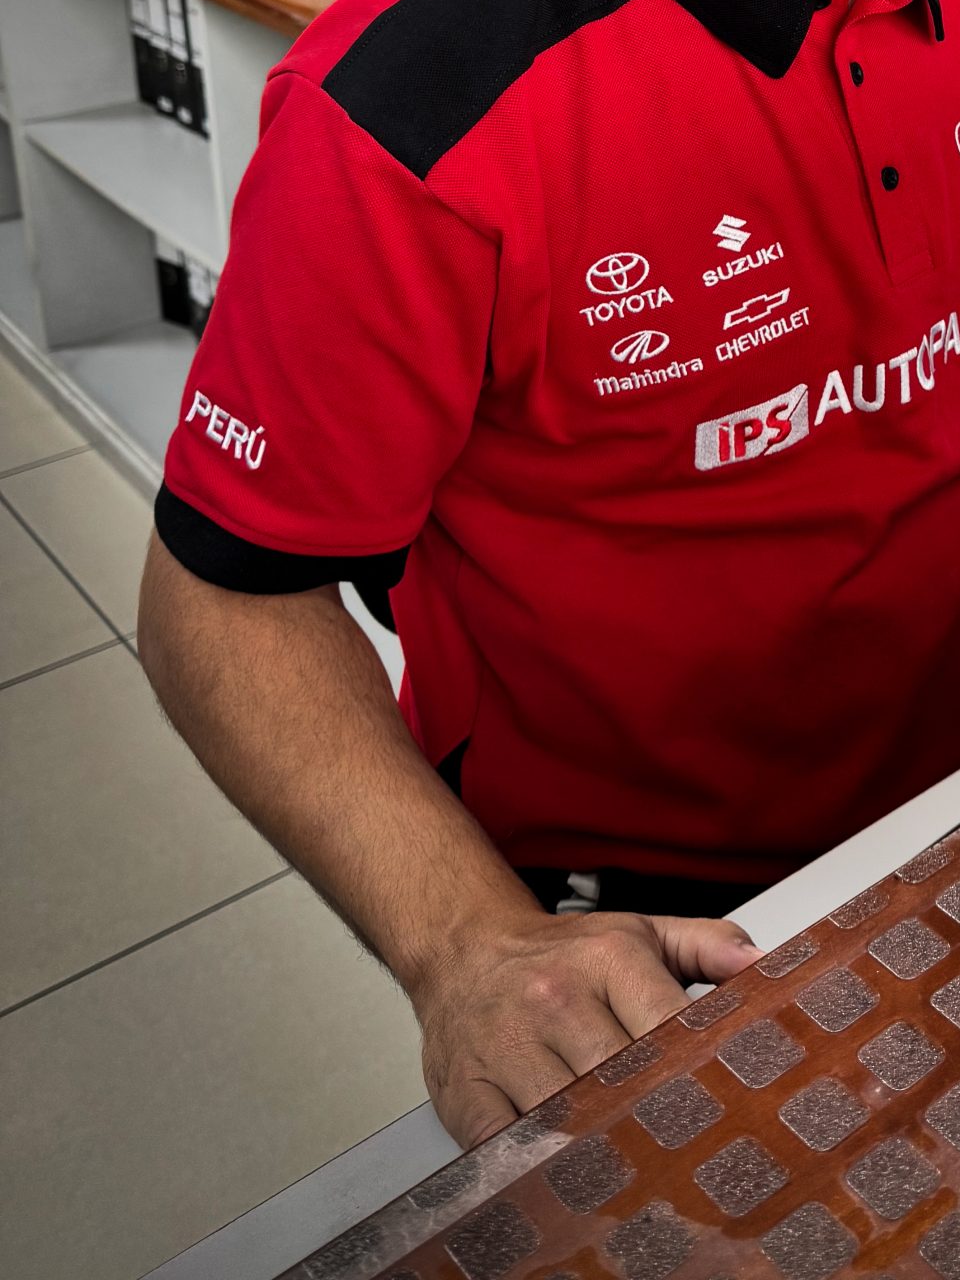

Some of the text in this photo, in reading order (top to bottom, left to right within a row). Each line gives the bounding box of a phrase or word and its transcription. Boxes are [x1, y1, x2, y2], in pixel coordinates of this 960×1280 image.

[702, 242, 784, 287] SUZUKI
[579, 285, 674, 326] TOYOTA
[716, 307, 810, 361] CHEVROLET
[184, 390, 266, 470] PERÚ
